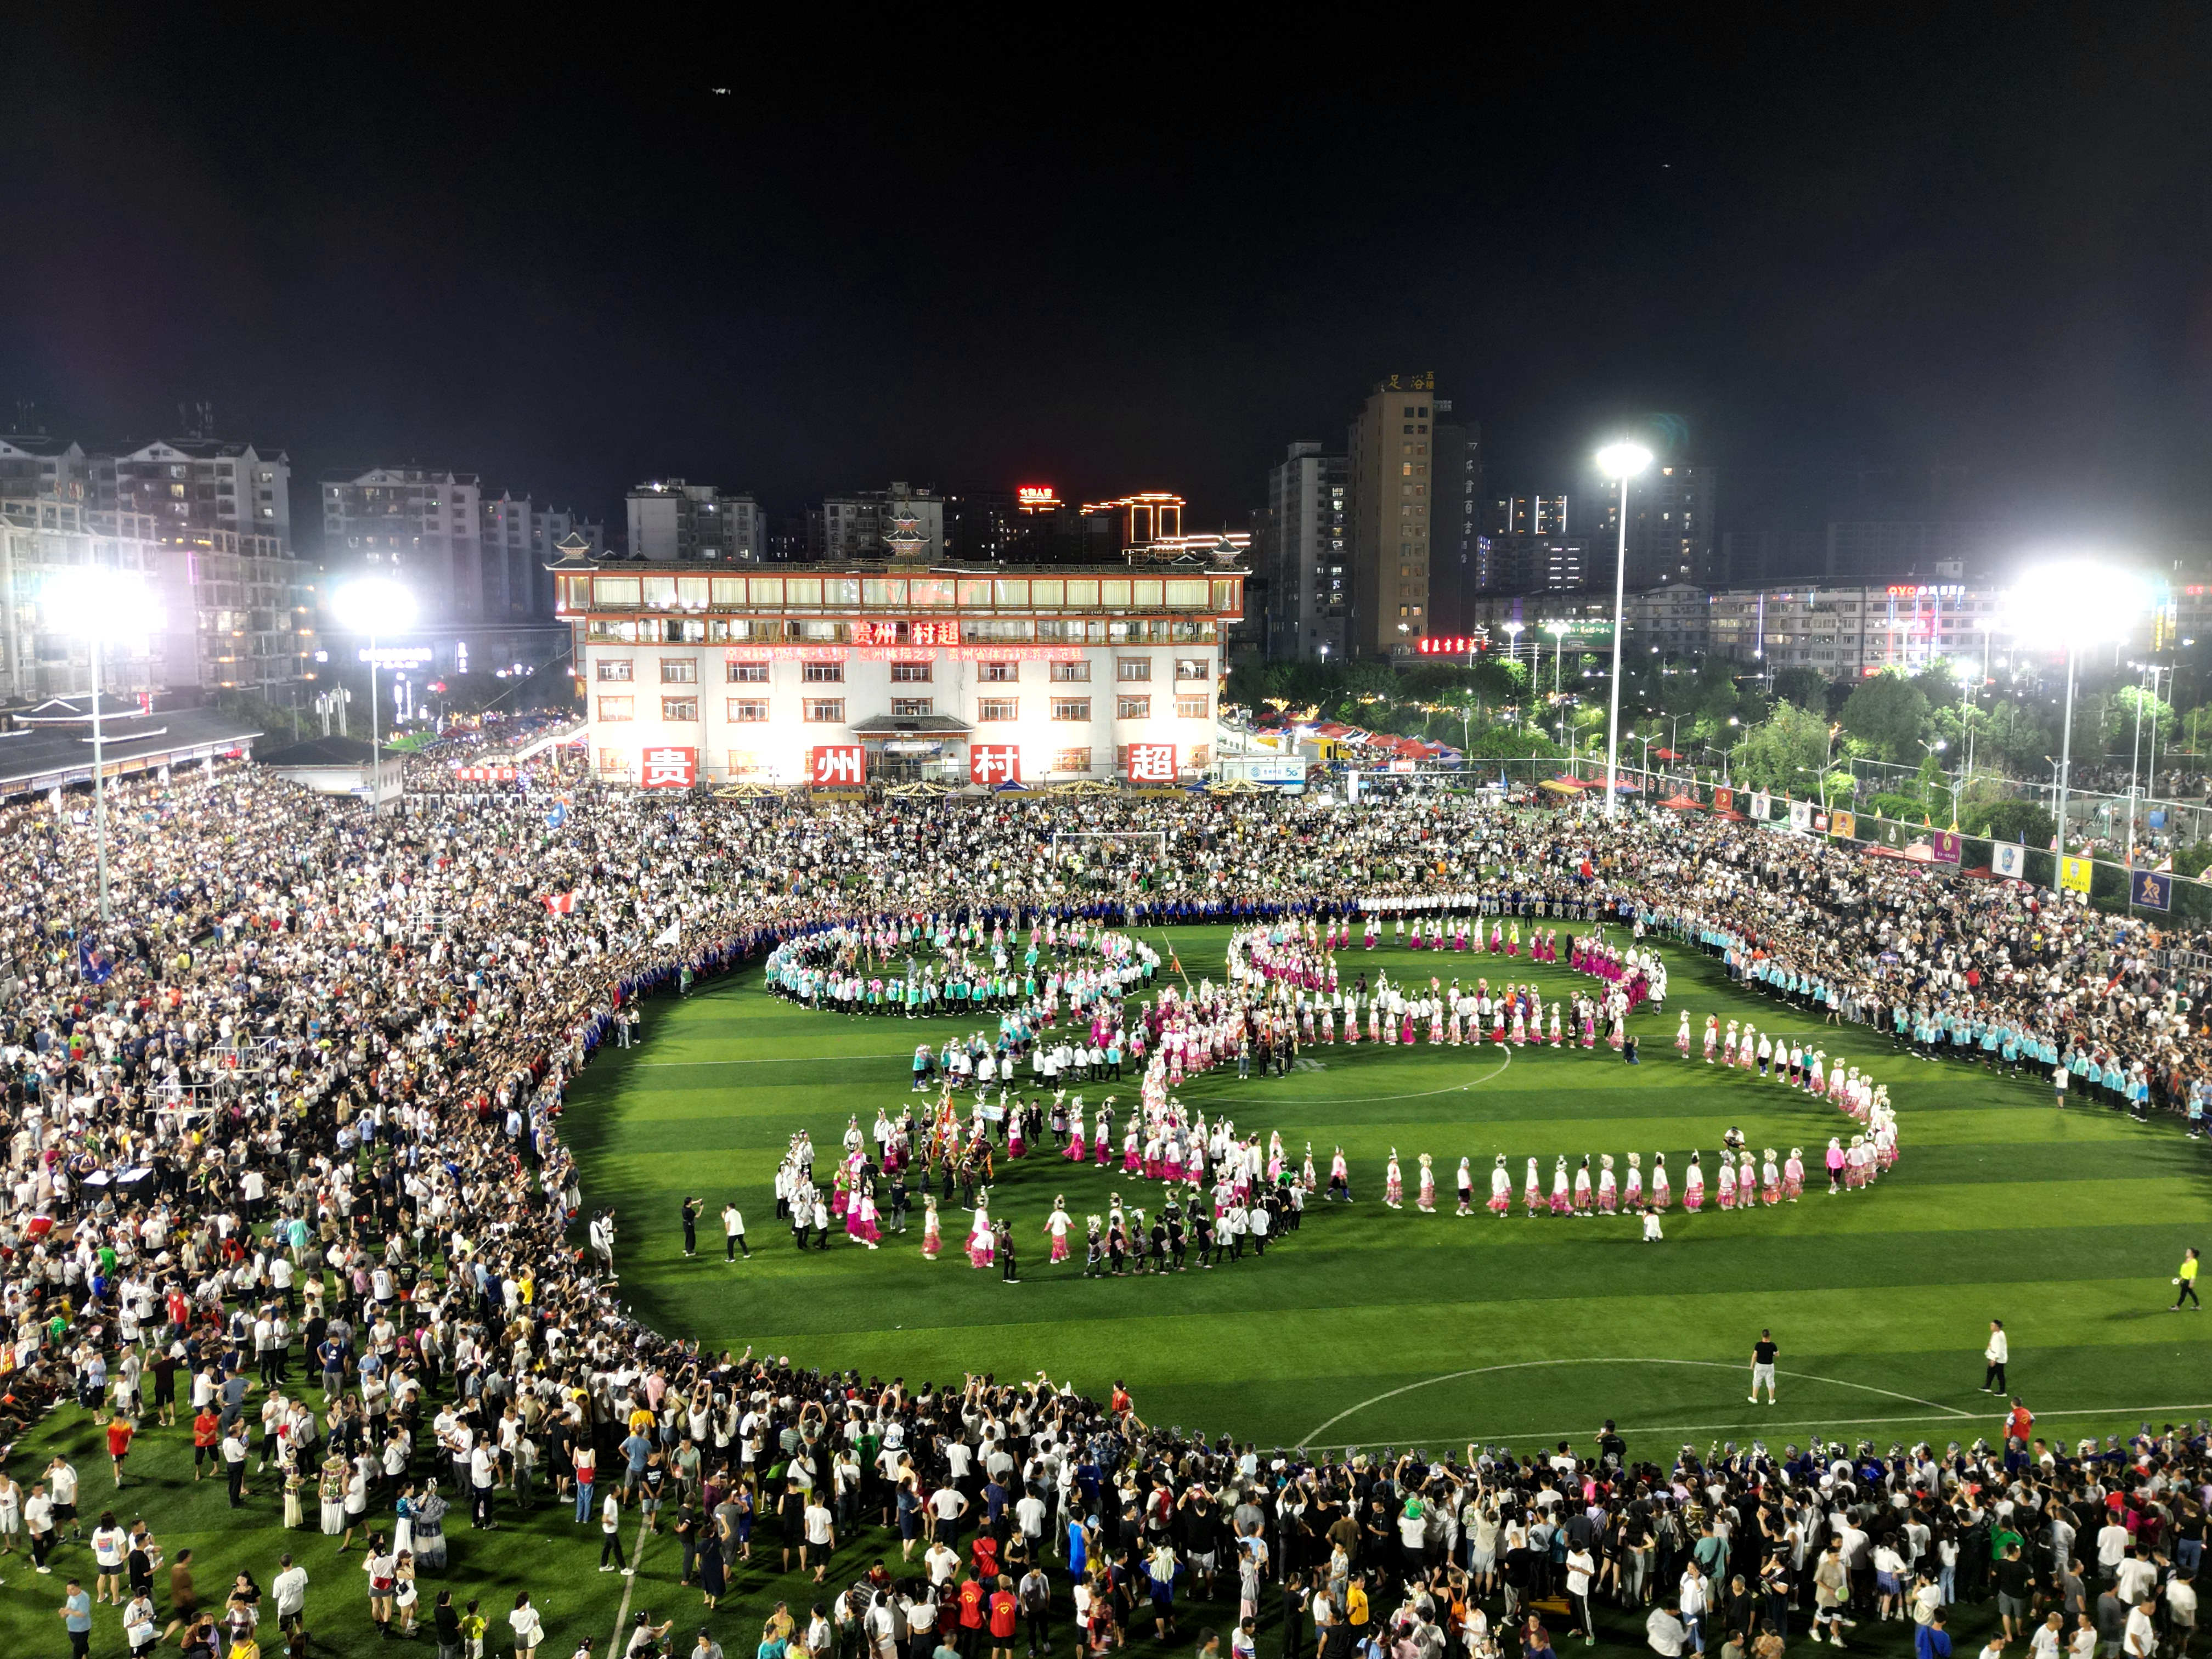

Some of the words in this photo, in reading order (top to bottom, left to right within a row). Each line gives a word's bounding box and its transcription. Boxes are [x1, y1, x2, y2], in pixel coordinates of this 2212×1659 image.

[1888, 586, 1916, 596] OYO
[850, 621, 897, 645] 贵州
[912, 621, 959, 645] 村超
[948, 647, 1082, 660] 贵州省体育旅游示范县
[645, 748, 691, 785] 贵
[817, 748, 861, 782] 州
[974, 746, 1018, 782] 村
[1131, 745, 1175, 780] 超
[1286, 768, 1298, 776] 5G
